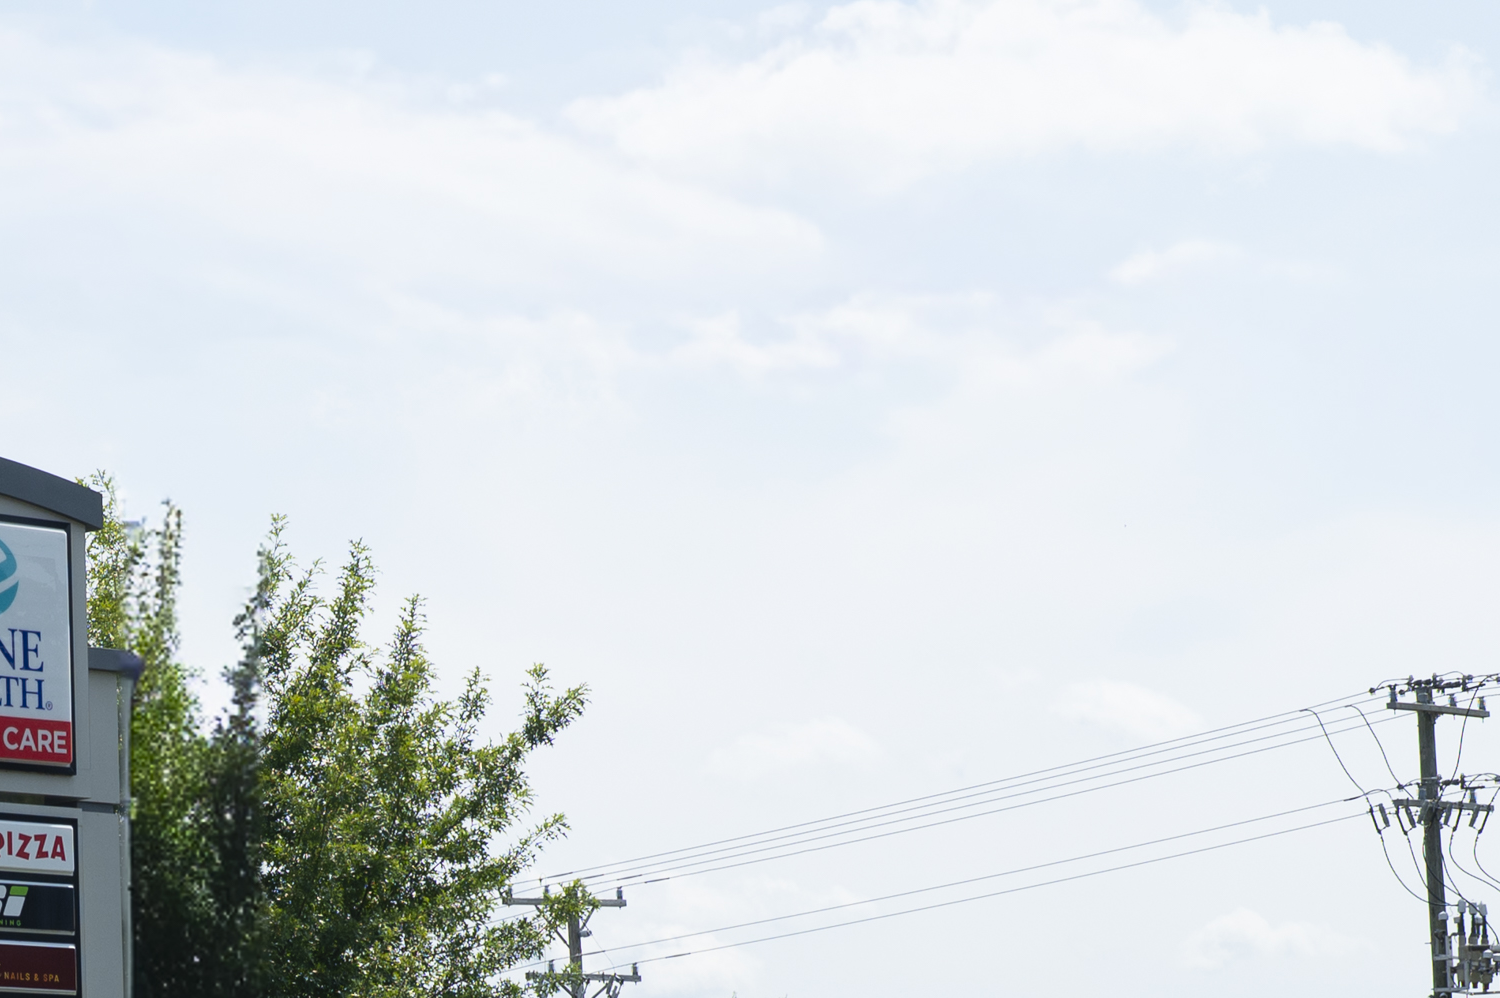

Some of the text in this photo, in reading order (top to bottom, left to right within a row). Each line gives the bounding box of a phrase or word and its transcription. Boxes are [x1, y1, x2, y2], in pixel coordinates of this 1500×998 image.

[3, 727, 67, 754] CARE
[4, 972, 30, 980] NAILS
[34, 973, 39, 981] &
[43, 974, 59, 982] SPA
